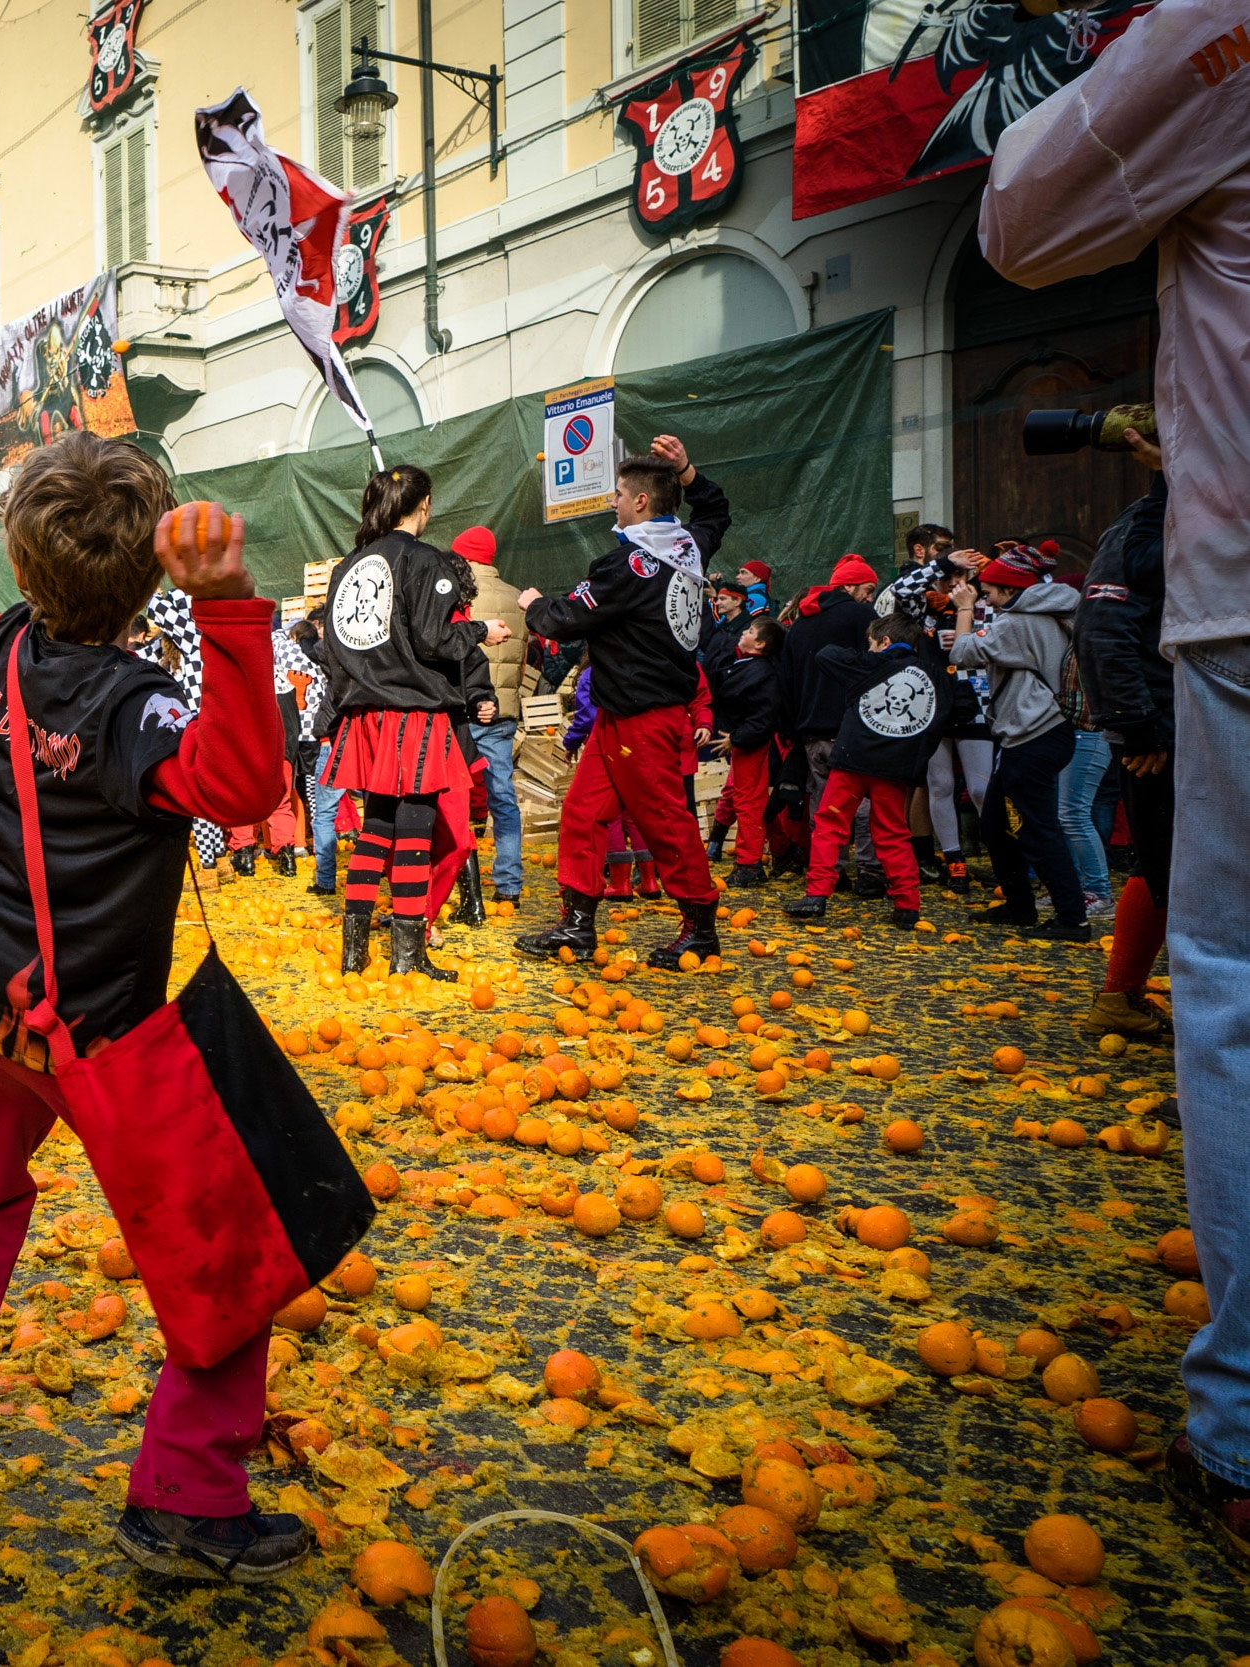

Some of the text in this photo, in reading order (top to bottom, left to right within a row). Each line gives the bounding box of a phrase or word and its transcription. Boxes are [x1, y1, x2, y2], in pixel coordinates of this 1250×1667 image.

[99, 3, 134, 45] 1 9
[94, 56, 127, 95] 5 4
[646, 67, 726, 132] 1 9
[646, 152, 723, 210] 5 4
[360, 223, 372, 249] 9
[354, 291, 366, 315] 4
[546, 391, 613, 416] Vittorio Emanuele
[558, 461, 571, 483] P
[669, 584, 680, 620] Storico
[899, 716, 928, 735] Morte
